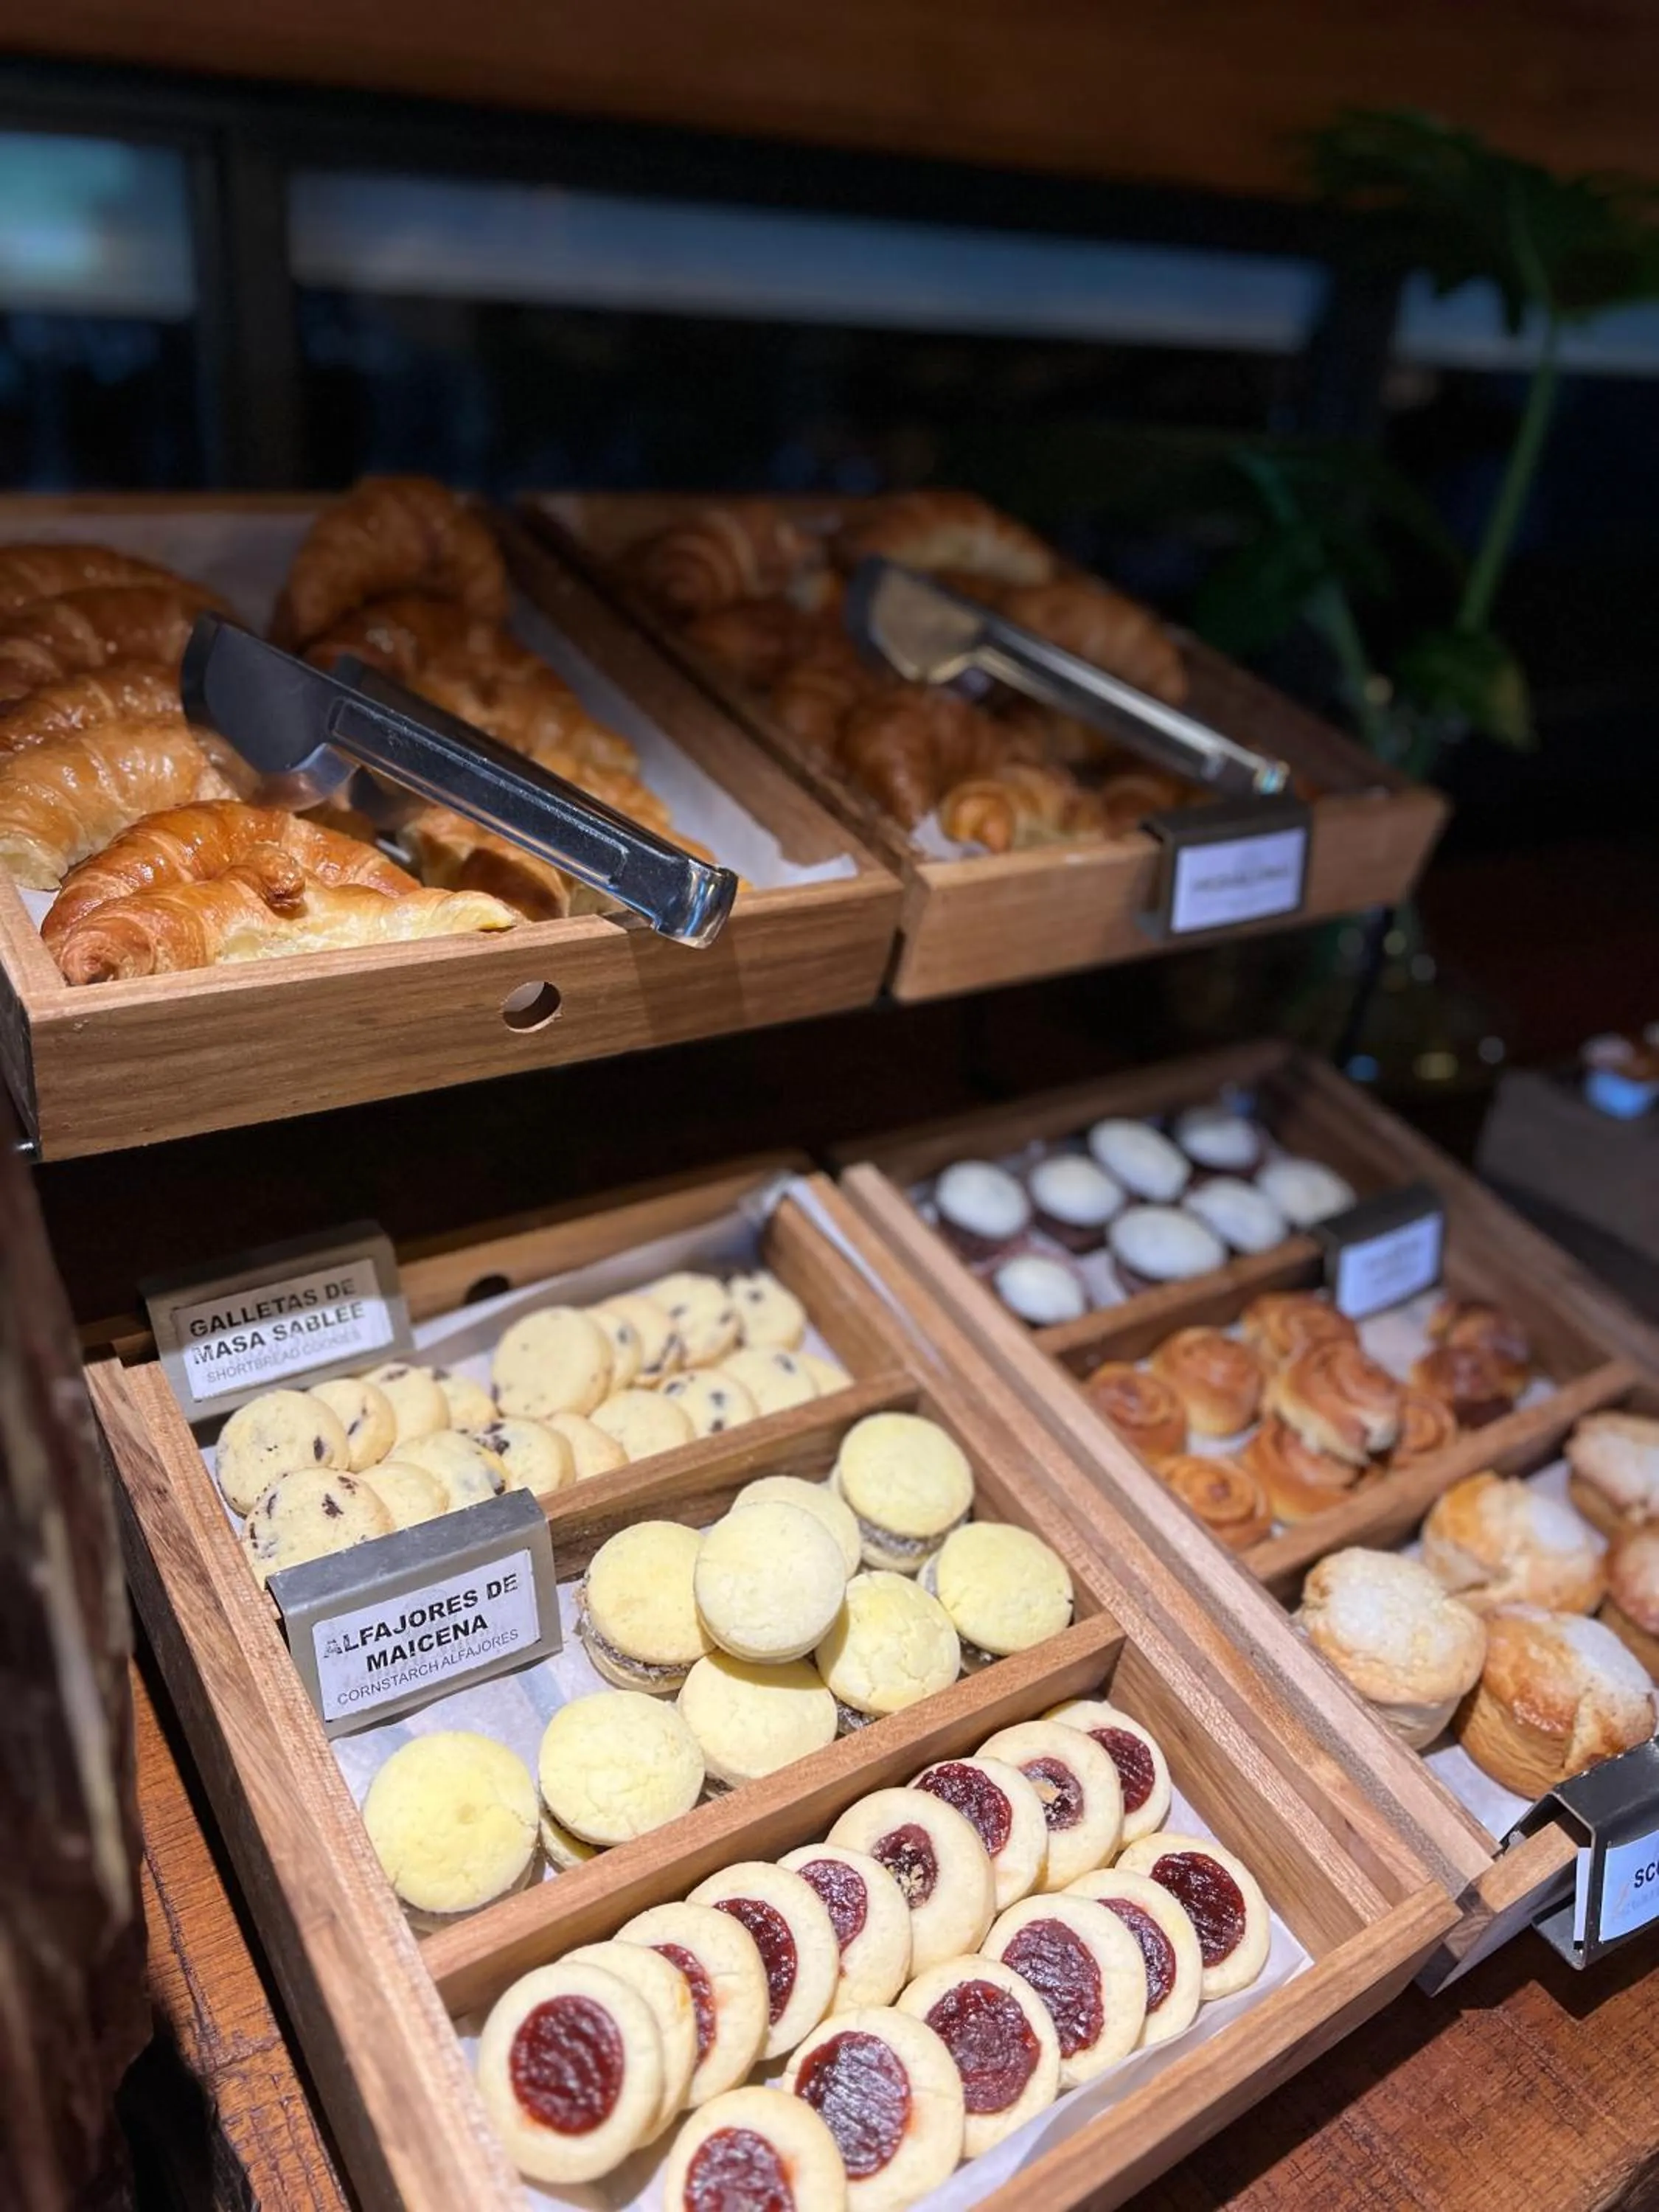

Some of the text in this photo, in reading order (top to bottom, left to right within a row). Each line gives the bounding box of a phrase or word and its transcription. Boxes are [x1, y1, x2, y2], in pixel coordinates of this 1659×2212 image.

[189, 1278, 356, 1338] GALLETAS DE
[191, 1331, 265, 1365] MASA
[207, 1348, 301, 1383] SHORTBREAD
[324, 1573, 519, 1658] ALFAJORES DE
[366, 1615, 488, 1672] MAICENA
[337, 1628, 519, 1705] CORNSTARCH ALFAJORES
